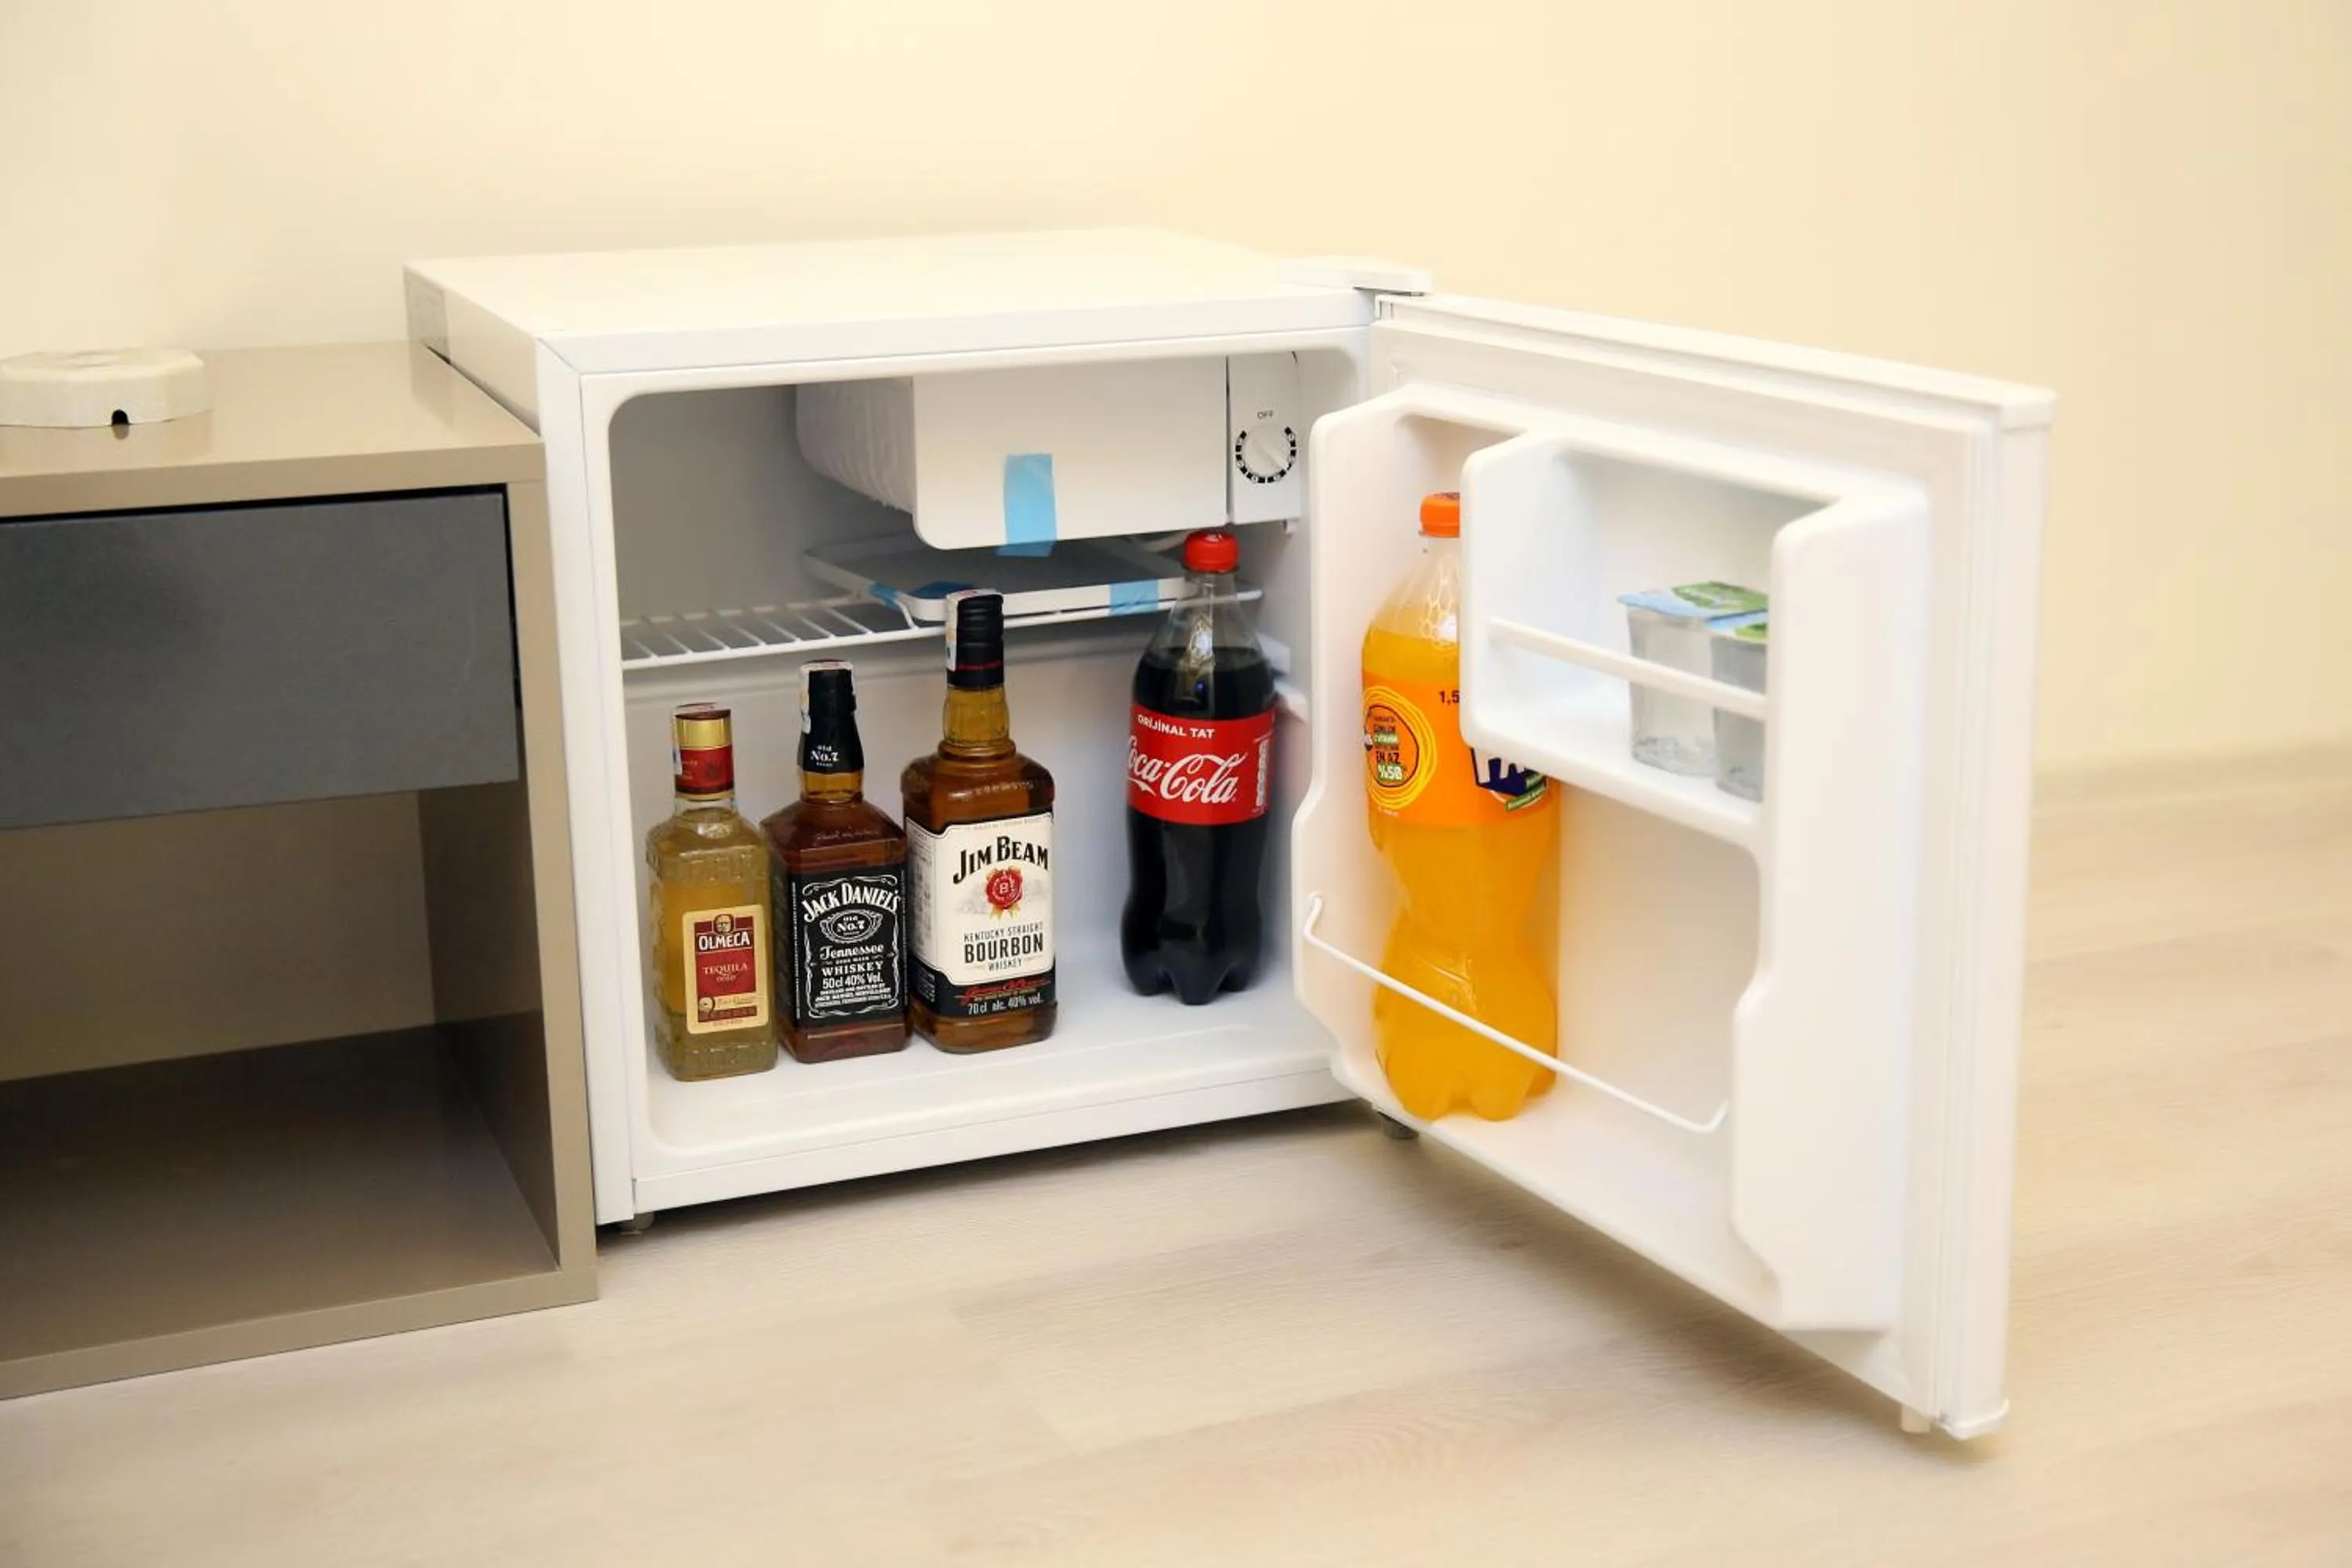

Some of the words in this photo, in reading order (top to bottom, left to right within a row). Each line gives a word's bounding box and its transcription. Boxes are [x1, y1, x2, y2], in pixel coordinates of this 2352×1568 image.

[1189, 727, 1215, 739] TAT
[953, 844, 993, 884] JIM
[996, 835, 1049, 871] BEAM
[801, 890, 841, 923] JACK
[841, 883, 901, 914] DANIEL'S
[964, 927, 1005, 942] KENTUCKY
[1007, 921, 1044, 937] STRAIGHT
[699, 931, 750, 951] OLMECA
[964, 932, 1044, 964] BOURBON
[819, 943, 885, 960] Tennessee
[702, 963, 749, 975] TEQUILA
[821, 960, 884, 977] WHISKEY
[844, 973, 866, 987] 40%
